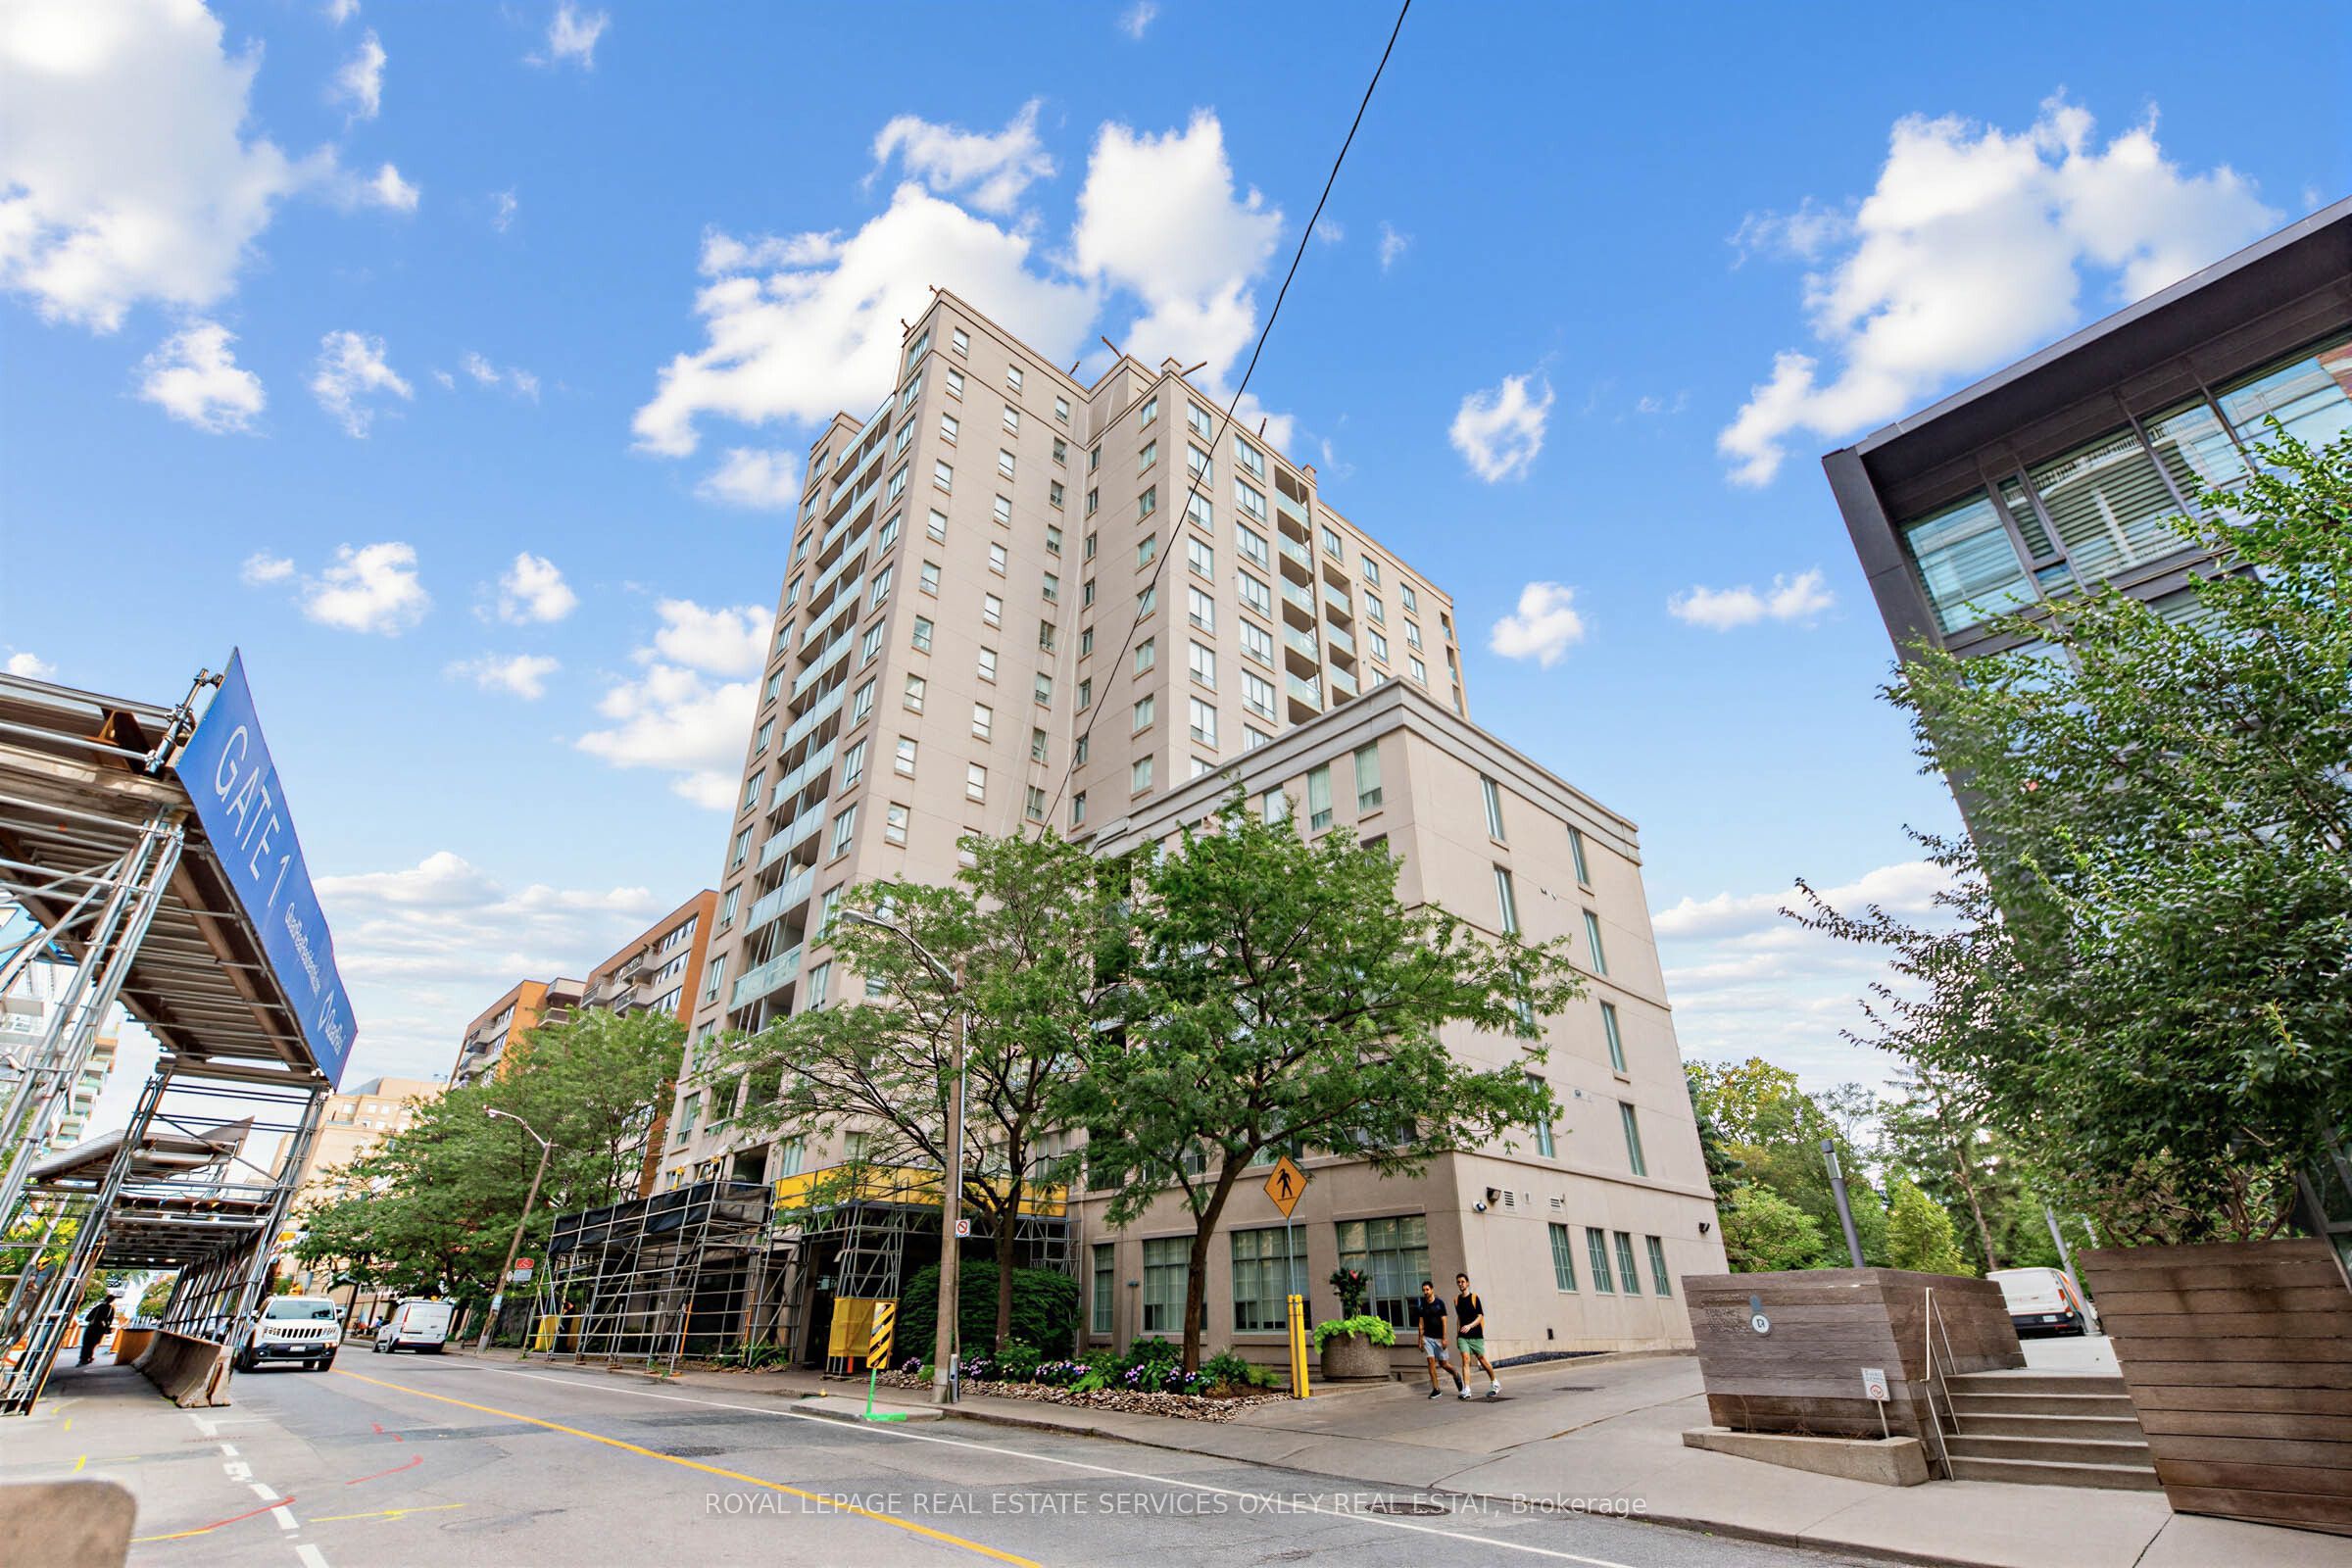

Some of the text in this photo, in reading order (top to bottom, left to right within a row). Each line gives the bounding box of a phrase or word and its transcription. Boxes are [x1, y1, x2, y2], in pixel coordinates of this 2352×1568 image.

[215, 724, 290, 908] GATE 1
[325, 1007, 346, 1056] QuadReal
